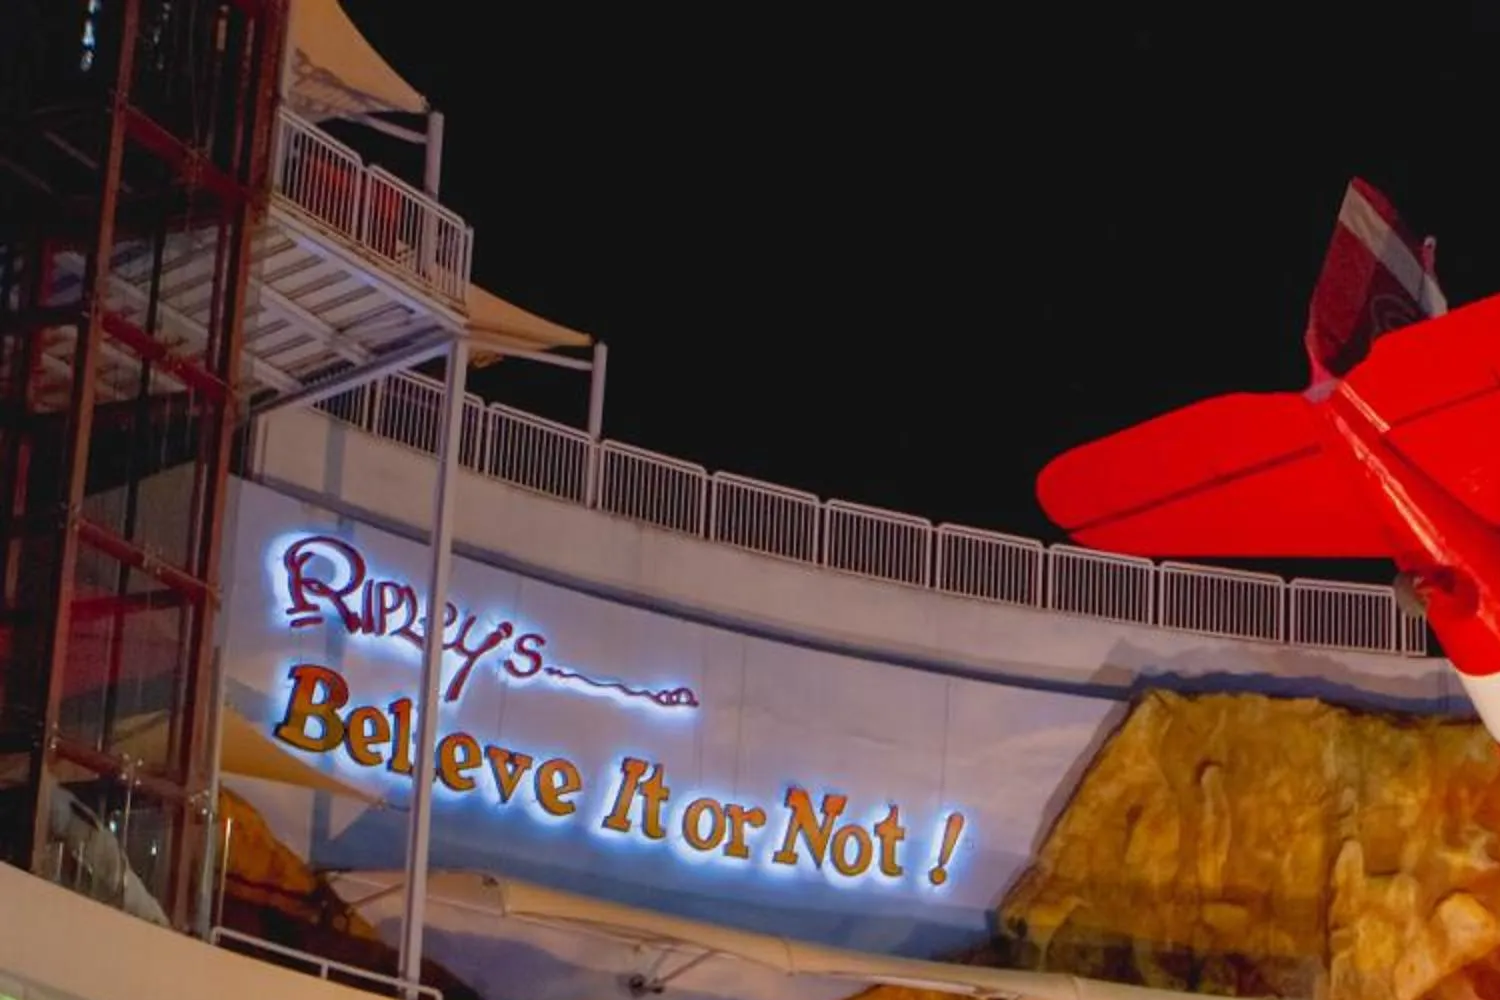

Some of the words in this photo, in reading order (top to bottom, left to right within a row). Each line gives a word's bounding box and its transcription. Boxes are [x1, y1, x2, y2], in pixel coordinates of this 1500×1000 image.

[274, 664, 584, 816] Beleve
[602, 757, 670, 840] It
[682, 797, 767, 858] or
[772, 785, 906, 878] Not
